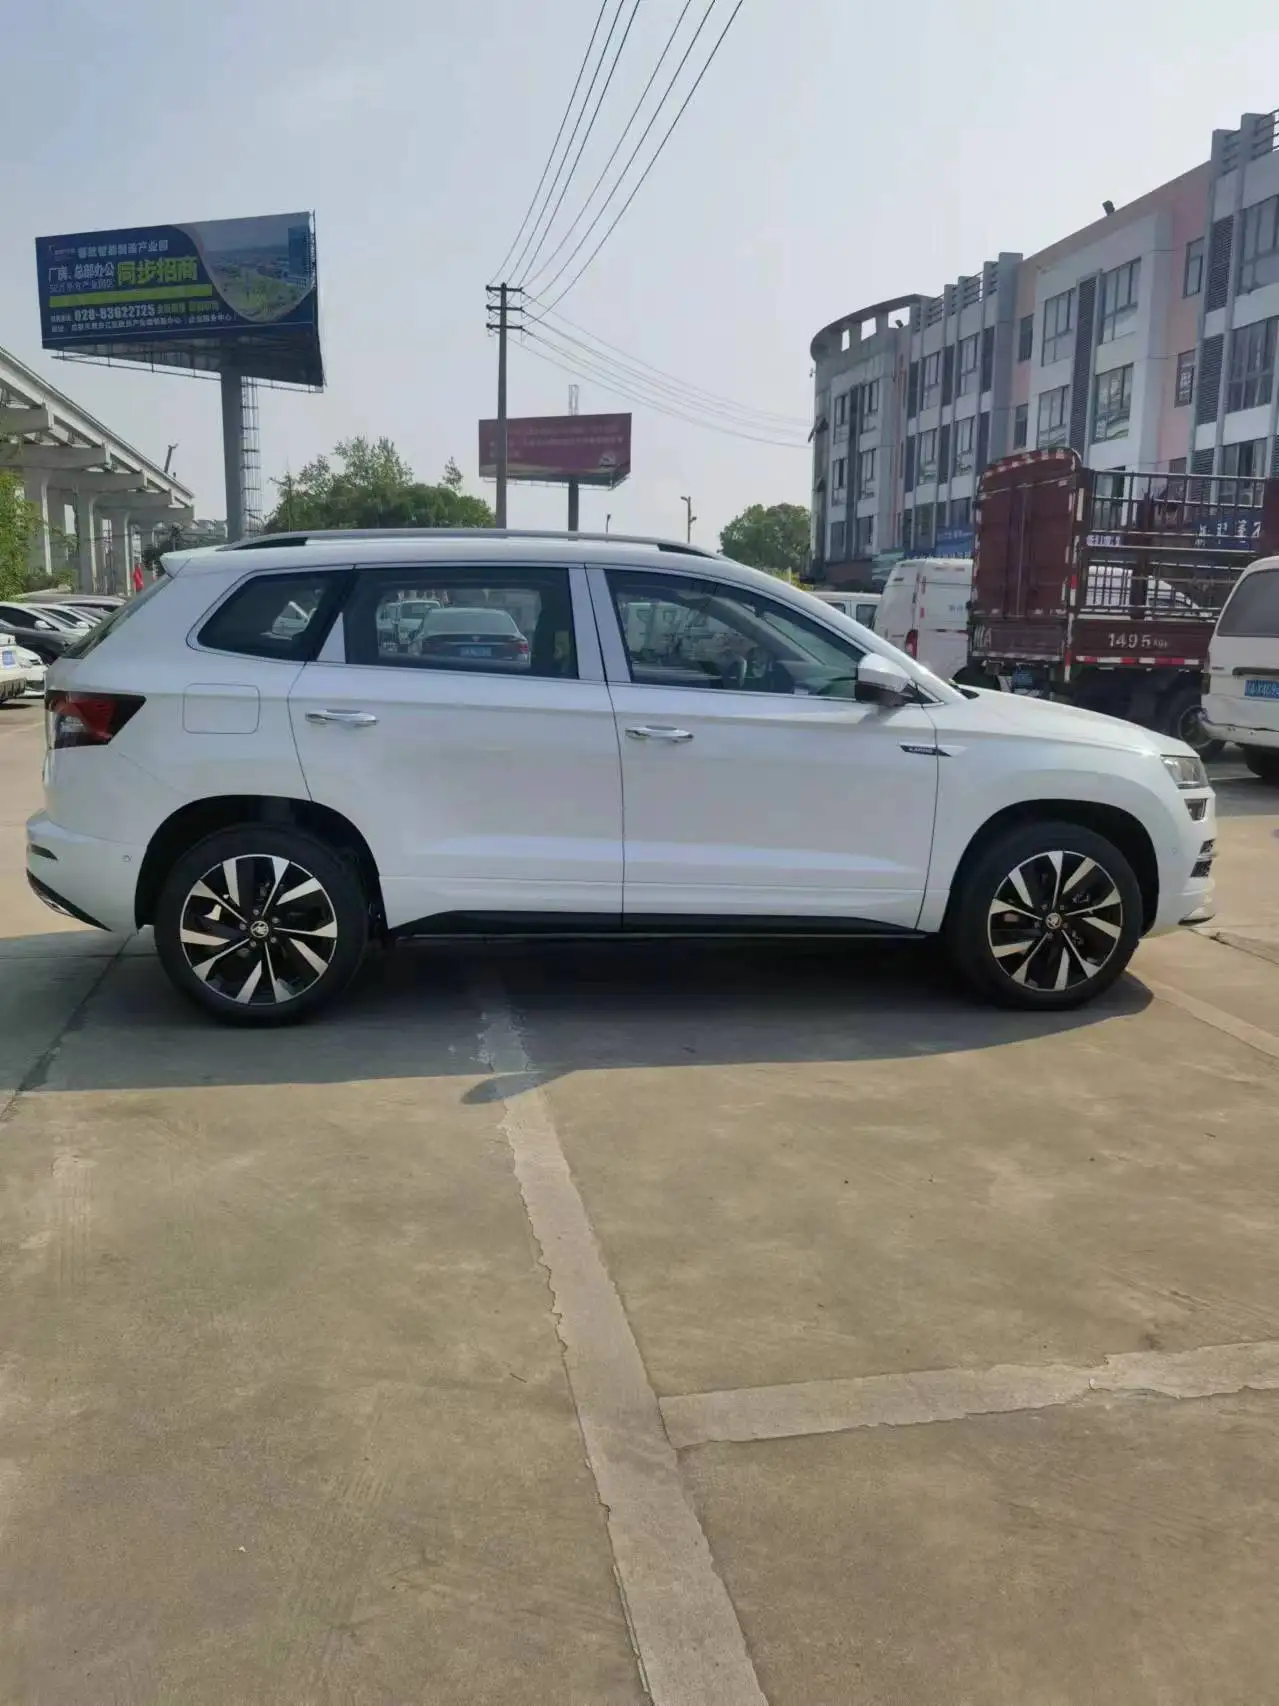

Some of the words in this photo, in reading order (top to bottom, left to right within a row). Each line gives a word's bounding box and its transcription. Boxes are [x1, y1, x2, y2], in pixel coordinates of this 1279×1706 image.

[118, 257, 198, 284] 同步招商
[1108, 632, 1152, 649] 1495
